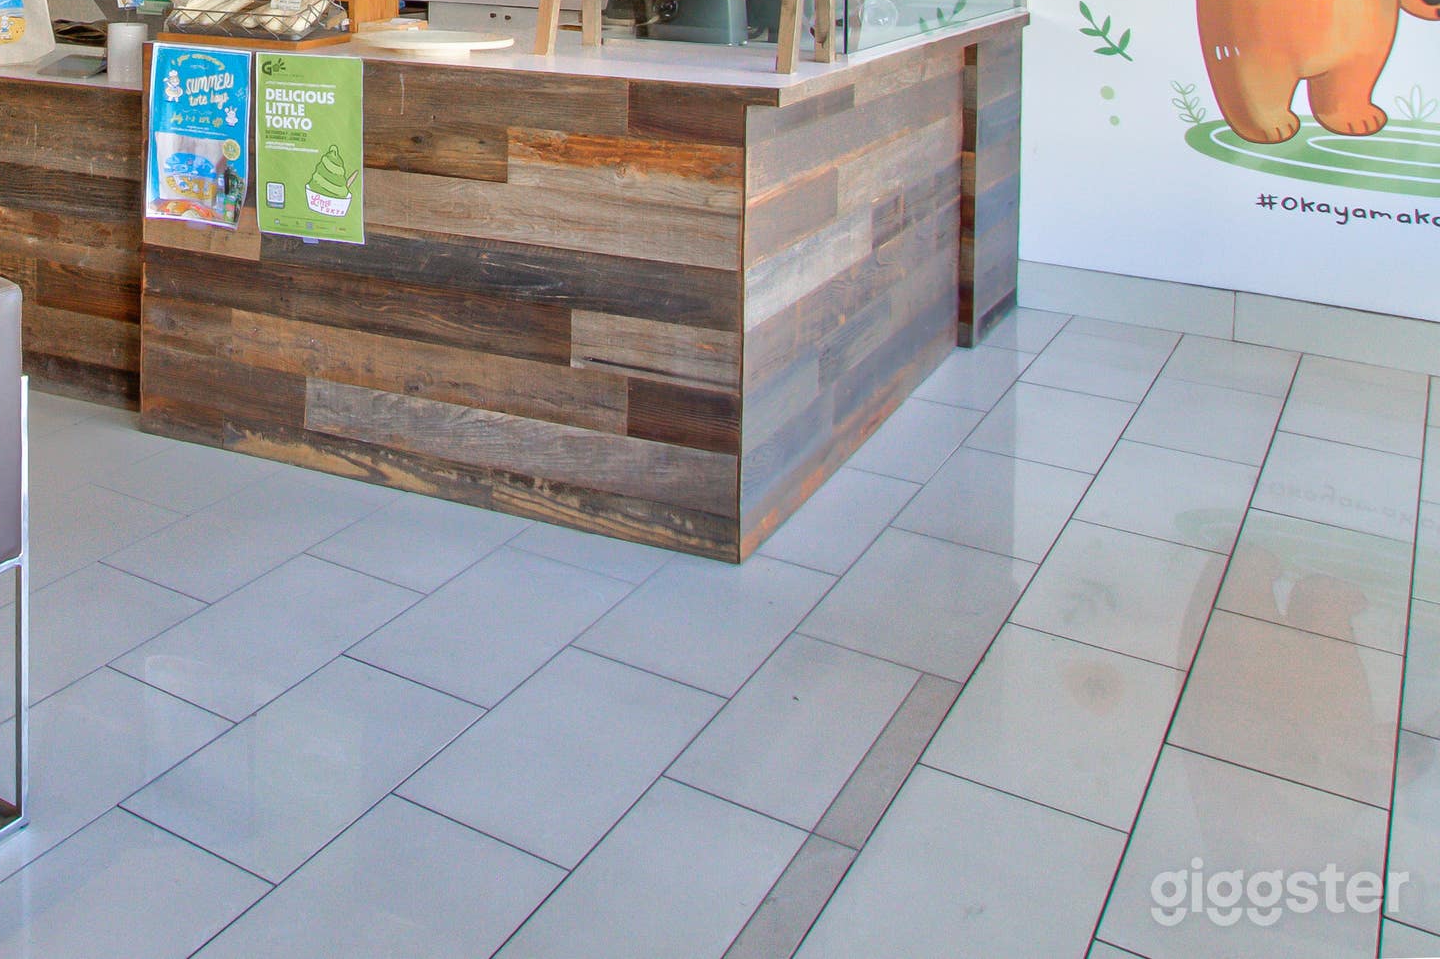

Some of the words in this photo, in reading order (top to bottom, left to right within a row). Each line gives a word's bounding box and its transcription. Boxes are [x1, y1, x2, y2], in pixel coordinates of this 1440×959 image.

[265, 88, 335, 105] DELICIOUS
[265, 101, 305, 116] LITTLE
[265, 115, 313, 131] TOKYO
